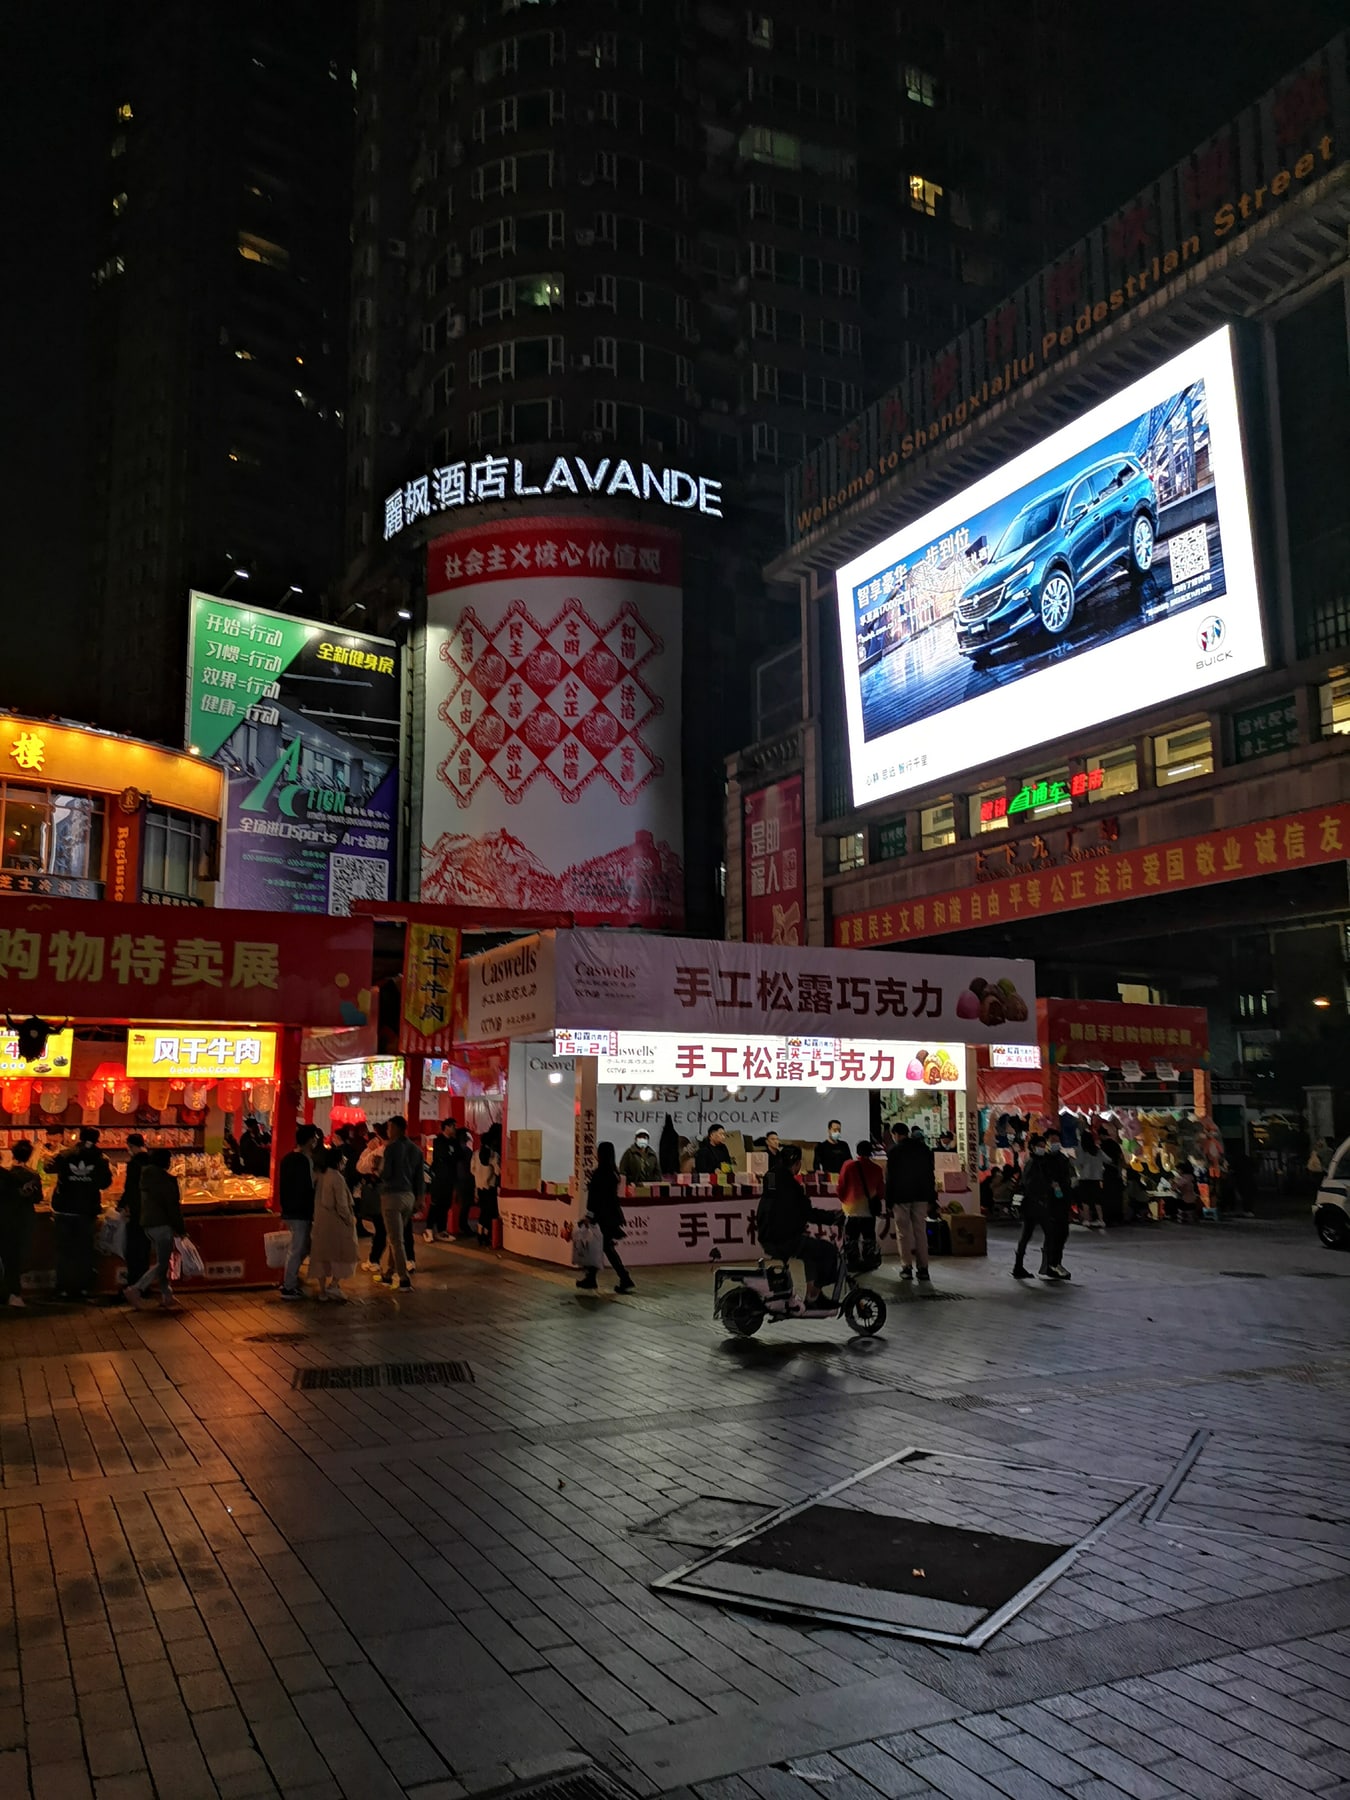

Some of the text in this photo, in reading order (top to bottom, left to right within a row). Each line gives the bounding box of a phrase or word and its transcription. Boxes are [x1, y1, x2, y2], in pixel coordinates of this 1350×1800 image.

[798, 468, 874, 531] Welcome
[879, 452, 898, 475] to
[1042, 235, 1200, 360] Pedestrian
[1214, 134, 1334, 237] Street
[513, 456, 723, 518] LAVANDE
[445, 540, 661, 579] 社会主义核心价值观
[206, 613, 283, 647] 开始=行动
[508, 622, 524, 658] 民主
[564, 619, 580, 656] 文明
[316, 642, 395, 675] 全新健身房
[1196, 650, 1233, 669] BUICK
[201, 666, 280, 700] 效果=行动
[508, 682, 523, 719] 平等
[564, 681, 579, 718] 公正
[200, 694, 280, 726] 健康=行动
[461, 689, 472, 724] 自由
[458, 748, 472, 786] 爱国
[563, 742, 579, 781] 诚信
[0, 928, 280, 990] 购物特卖展
[481, 945, 538, 987] Caswells
[575, 959, 637, 980] Caswells
[419, 934, 451, 1022] 风干牛肉
[673, 965, 942, 1018] 手工松露巧克力
[153, 1037, 261, 1064] 风干牛肉
[790, 1048, 833, 1060] 买一送一
[686, 1110, 779, 1124] CHOCOLATE
[510, 1212, 559, 1238] 手工松露巧克力
